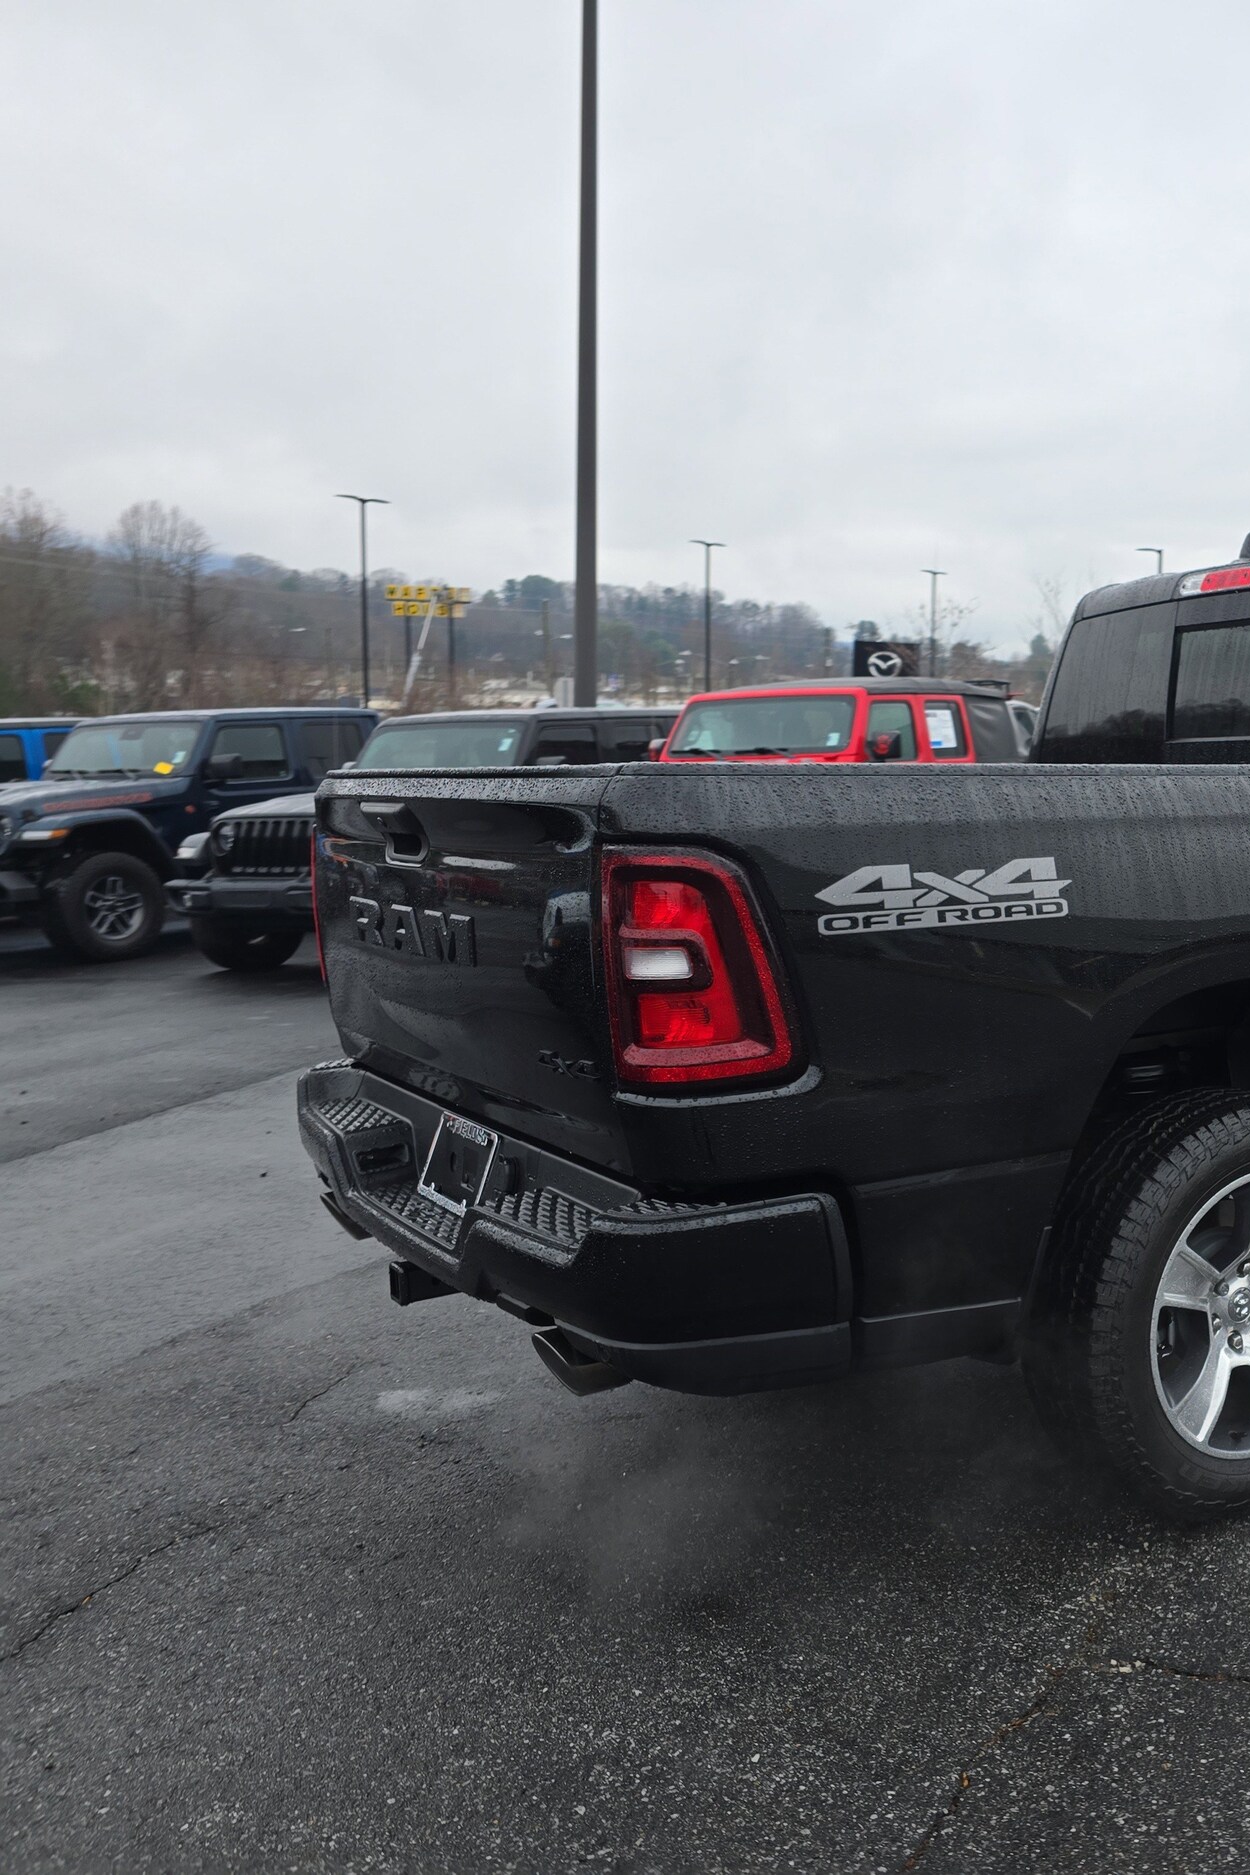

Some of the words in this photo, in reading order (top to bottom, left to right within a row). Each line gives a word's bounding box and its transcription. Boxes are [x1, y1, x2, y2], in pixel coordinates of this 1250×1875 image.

[386, 584, 471, 600] WAFL
[349, 895, 477, 967] RAM
[823, 910, 929, 931] OFF
[937, 903, 1065, 923] ROAD
